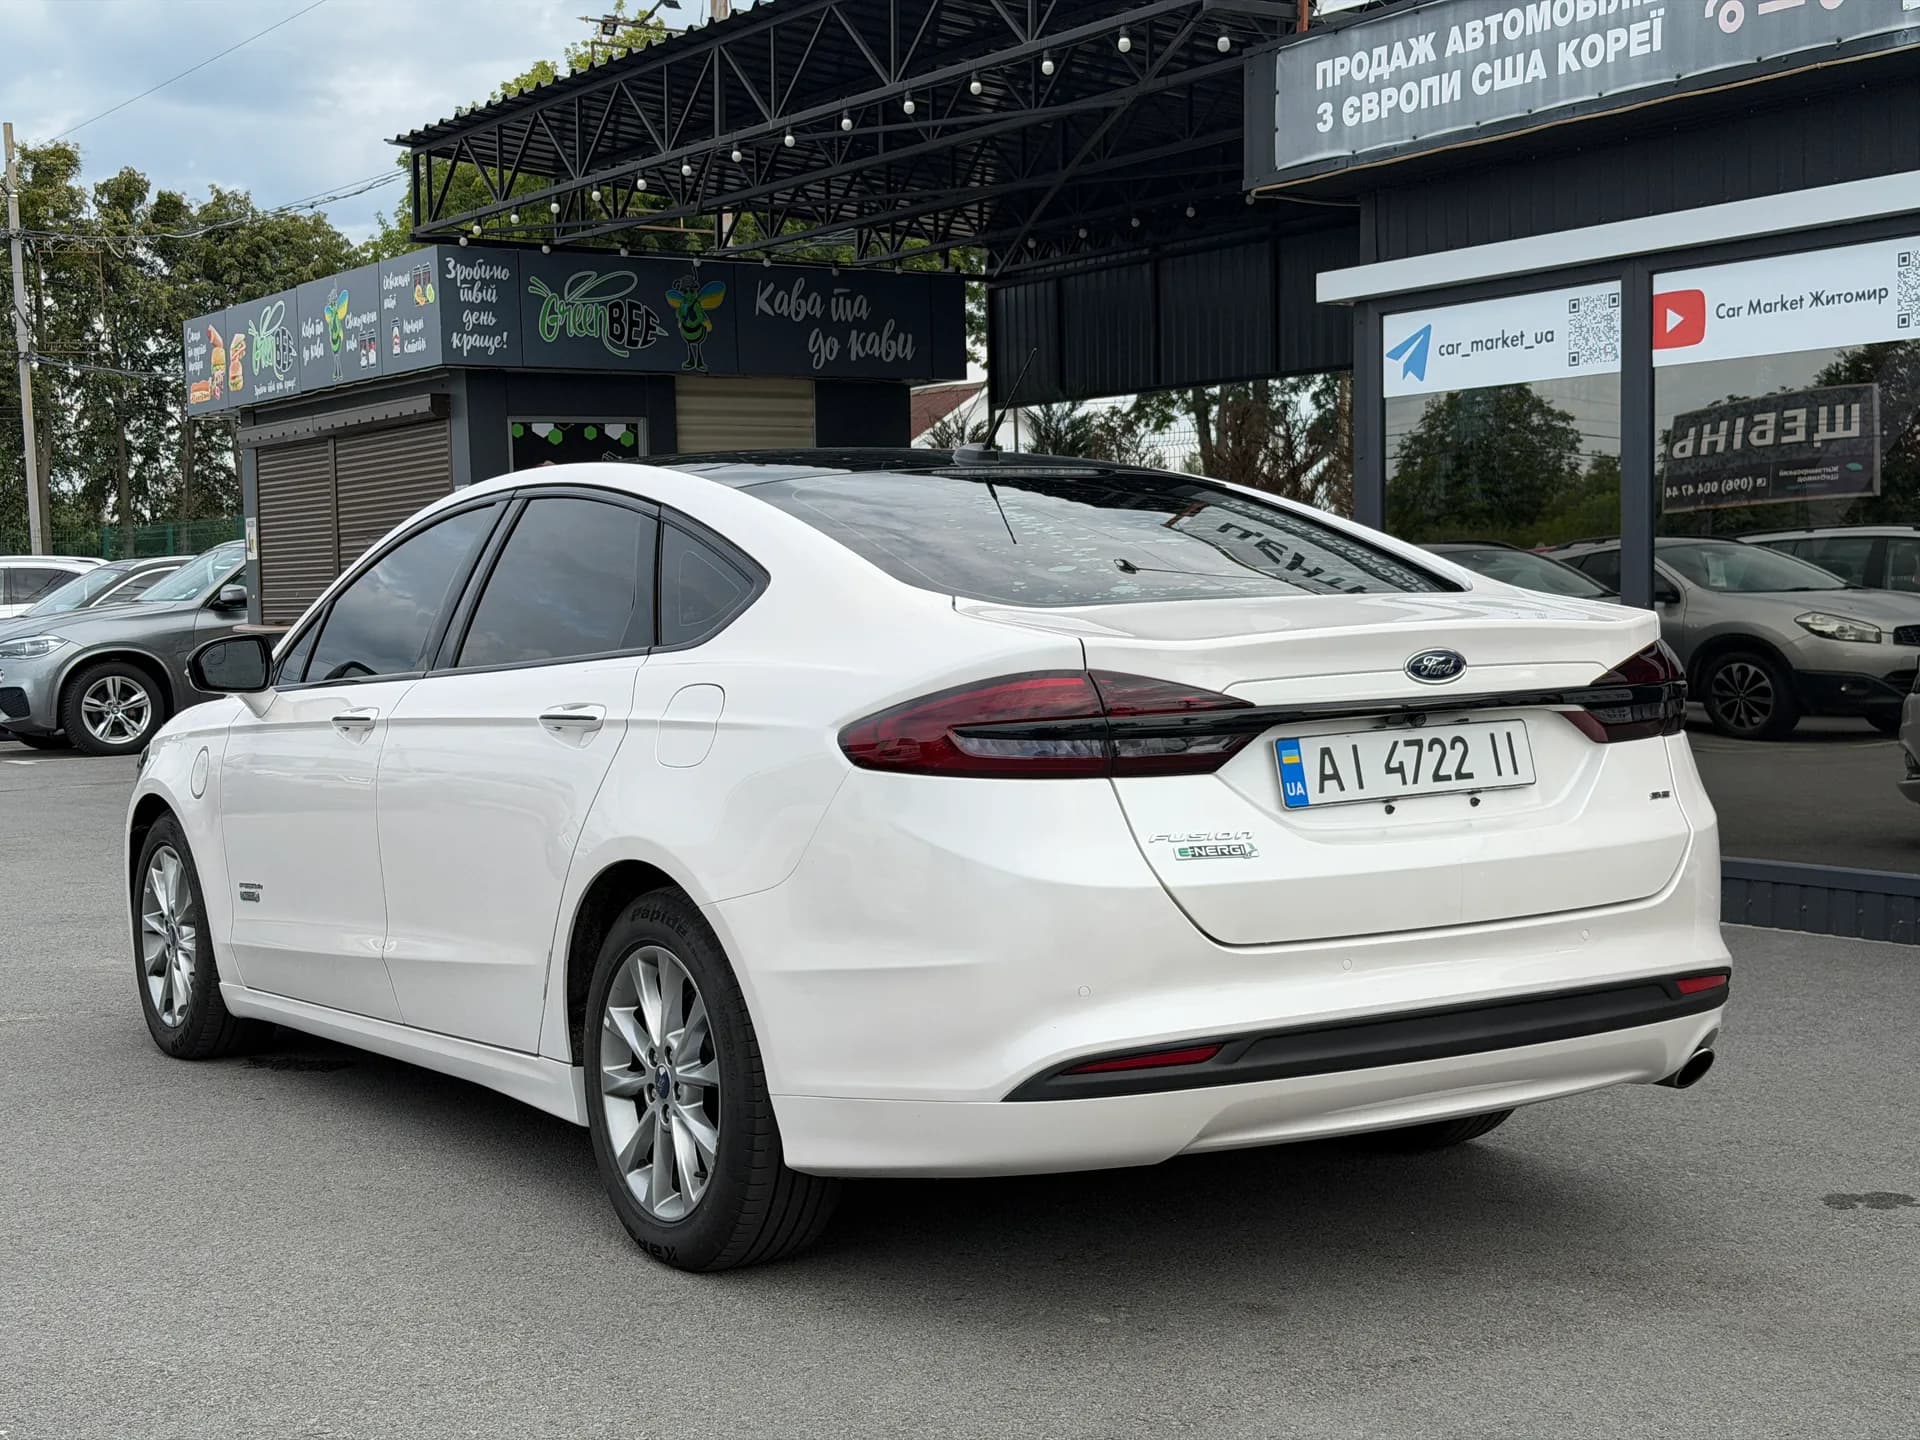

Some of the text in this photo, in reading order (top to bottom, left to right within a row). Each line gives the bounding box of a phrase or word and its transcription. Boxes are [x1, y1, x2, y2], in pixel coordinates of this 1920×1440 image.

[1316, 32, 1437, 90] ПРОДАЖ
[1317, 8, 1664, 133] З ЄВРОПИ США КОРЕЇ
[445, 257, 511, 286] Зробимо
[459, 280, 498, 304] твій
[756, 277, 871, 323] Кава та
[1715, 286, 1889, 319] Car Market Житомир
[462, 309, 497, 331] день
[451, 331, 508, 357] краще!
[808, 319, 916, 370] до кави
[1438, 329, 1555, 358] car_market_ua
[1318, 731, 1519, 794] AI 4722 II
[1286, 782, 1305, 797] UA
